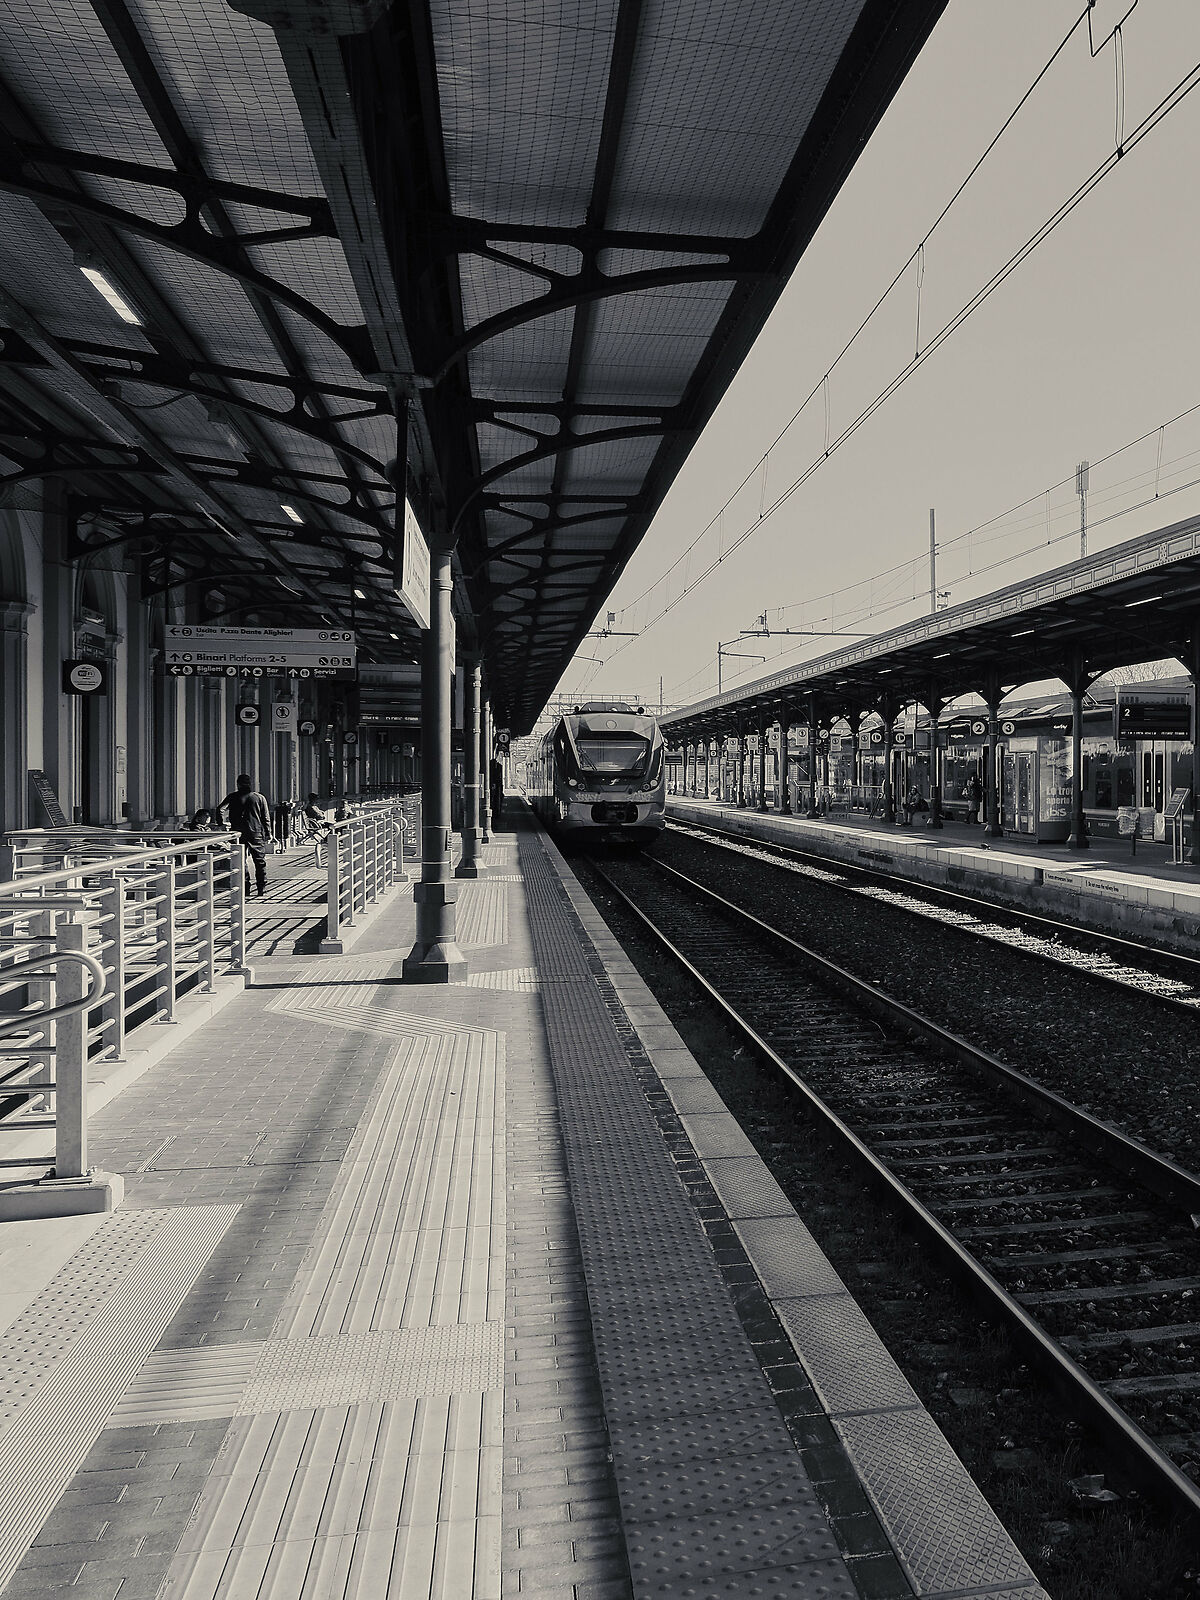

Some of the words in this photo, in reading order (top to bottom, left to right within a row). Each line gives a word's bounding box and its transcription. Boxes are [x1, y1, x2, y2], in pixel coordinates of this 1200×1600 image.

[230, 654, 267, 662] Platforms
[1124, 708, 1130, 717] 2
[975, 724, 982, 732] 2
[1005, 724, 1011, 732] 3
